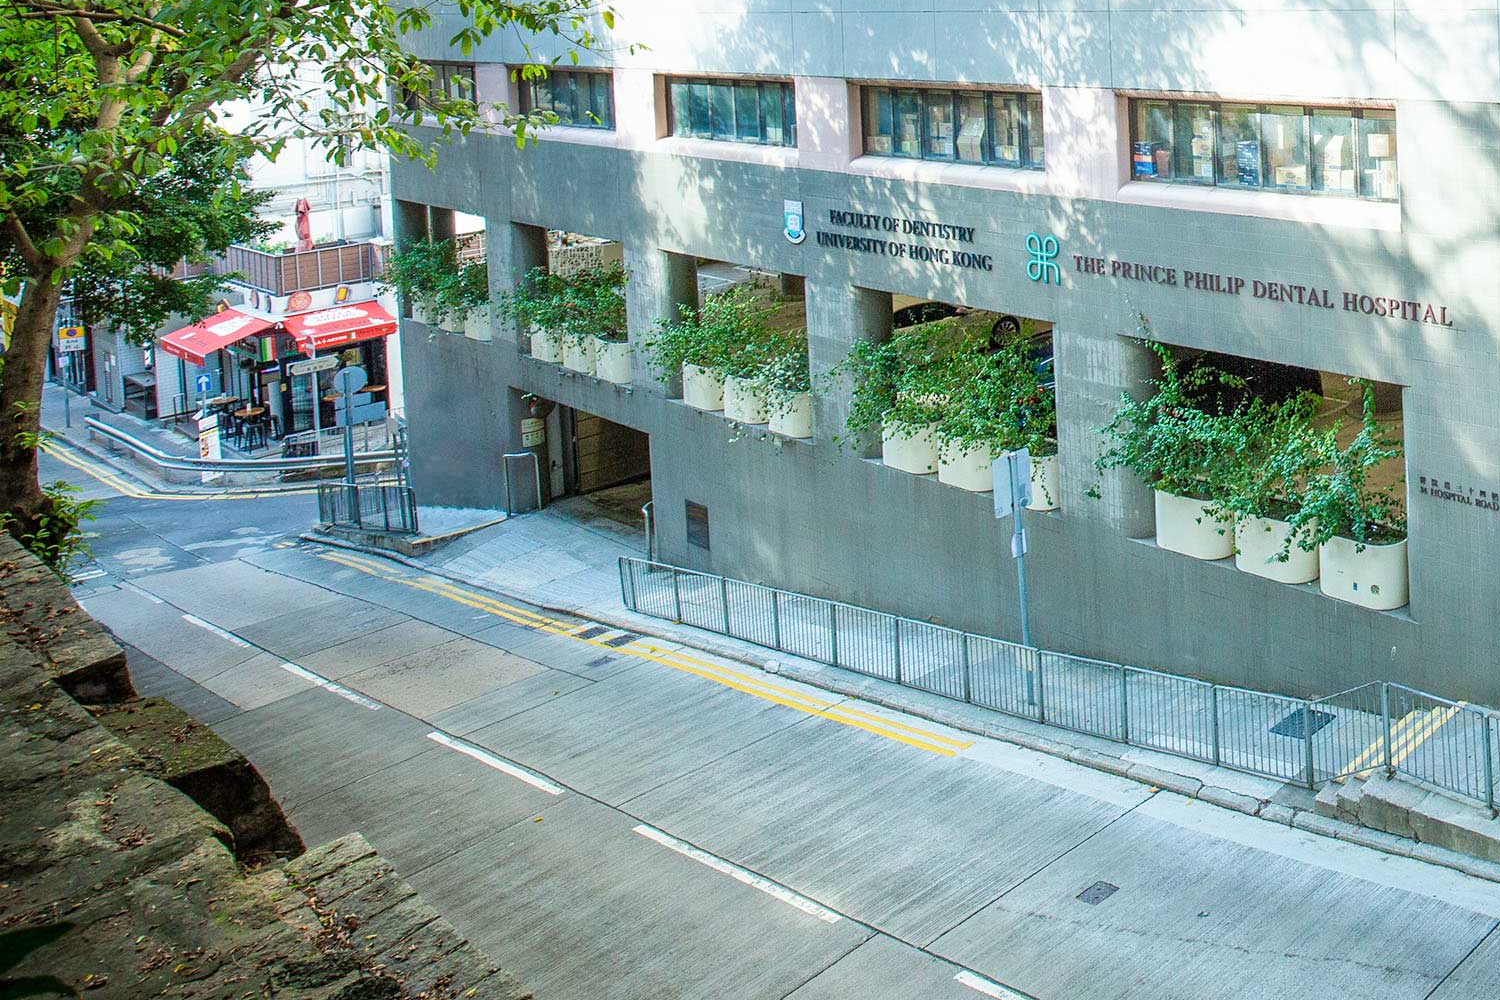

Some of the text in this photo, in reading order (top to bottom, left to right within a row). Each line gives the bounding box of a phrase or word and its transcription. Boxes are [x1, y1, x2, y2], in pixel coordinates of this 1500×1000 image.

[829, 209, 976, 244] FACULTY OF DENTISTRY
[816, 231, 993, 272] UNIVERSITY OF HONG KONG
[1073, 254, 1454, 328] THE PRINCE PHILIP DENTAL HOSPITAL
[1430, 487, 1473, 506] HOSPITAL
[1475, 498, 1500, 512] ROAD
